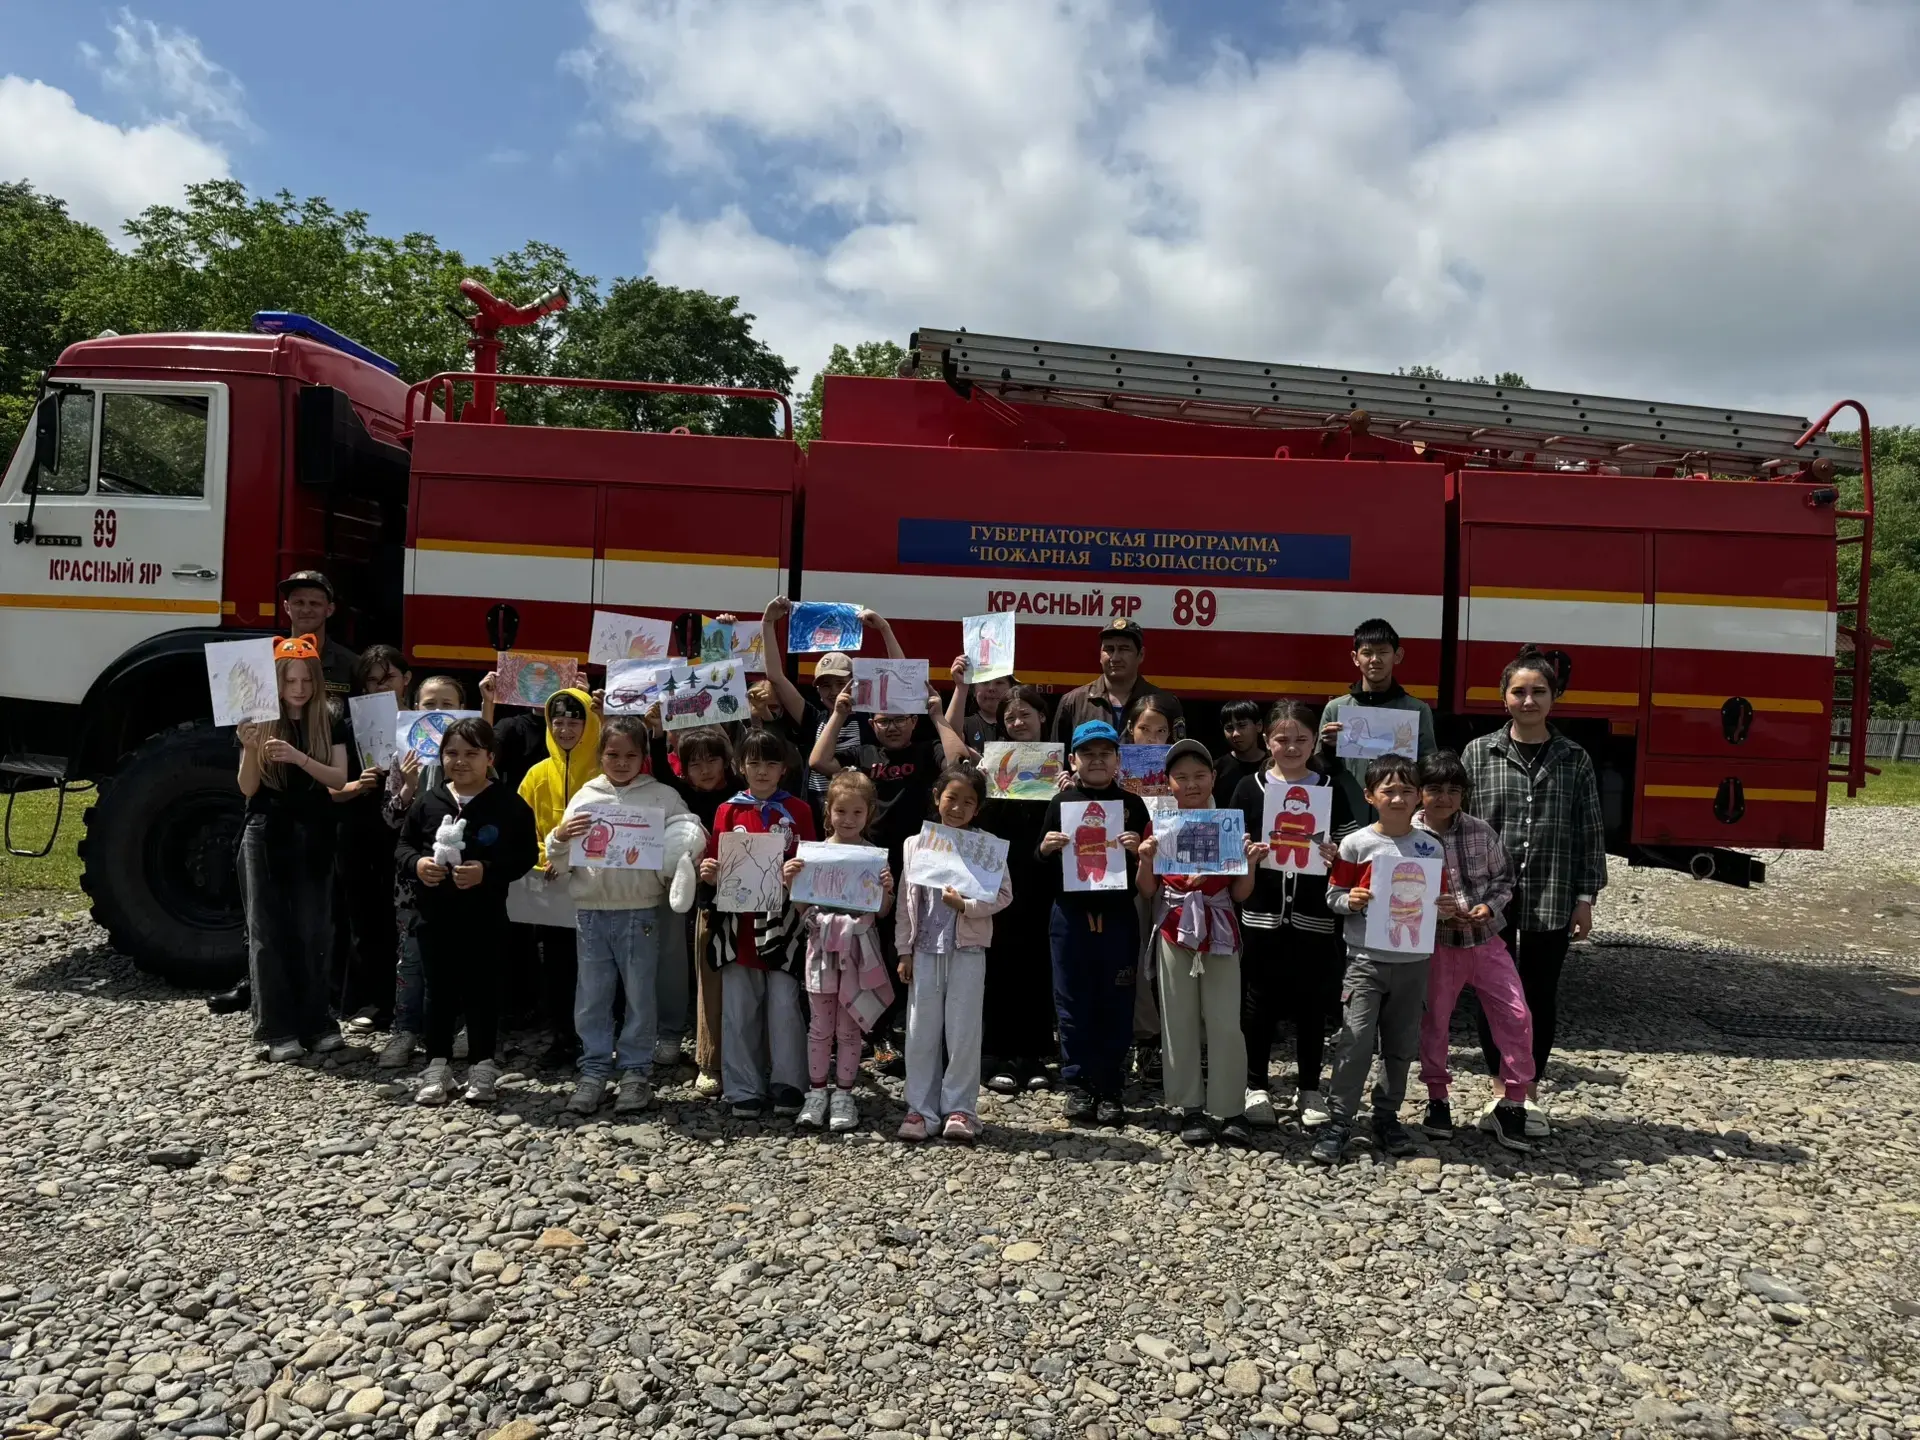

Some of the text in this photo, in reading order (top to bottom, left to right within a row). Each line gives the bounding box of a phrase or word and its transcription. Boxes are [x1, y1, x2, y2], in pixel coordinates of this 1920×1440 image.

[38, 537, 79, 546] 43118
[93, 508, 117, 548] 89
[969, 525, 1280, 553] ГУБЕРНАТОРСКАЯ ПРОГРАММА
[49, 557, 162, 585] КРАСНЫЙ ЯР
[987, 588, 1217, 627] КРАСНЫЙ ЯР 89
[1222, 816, 1240, 834] 01
